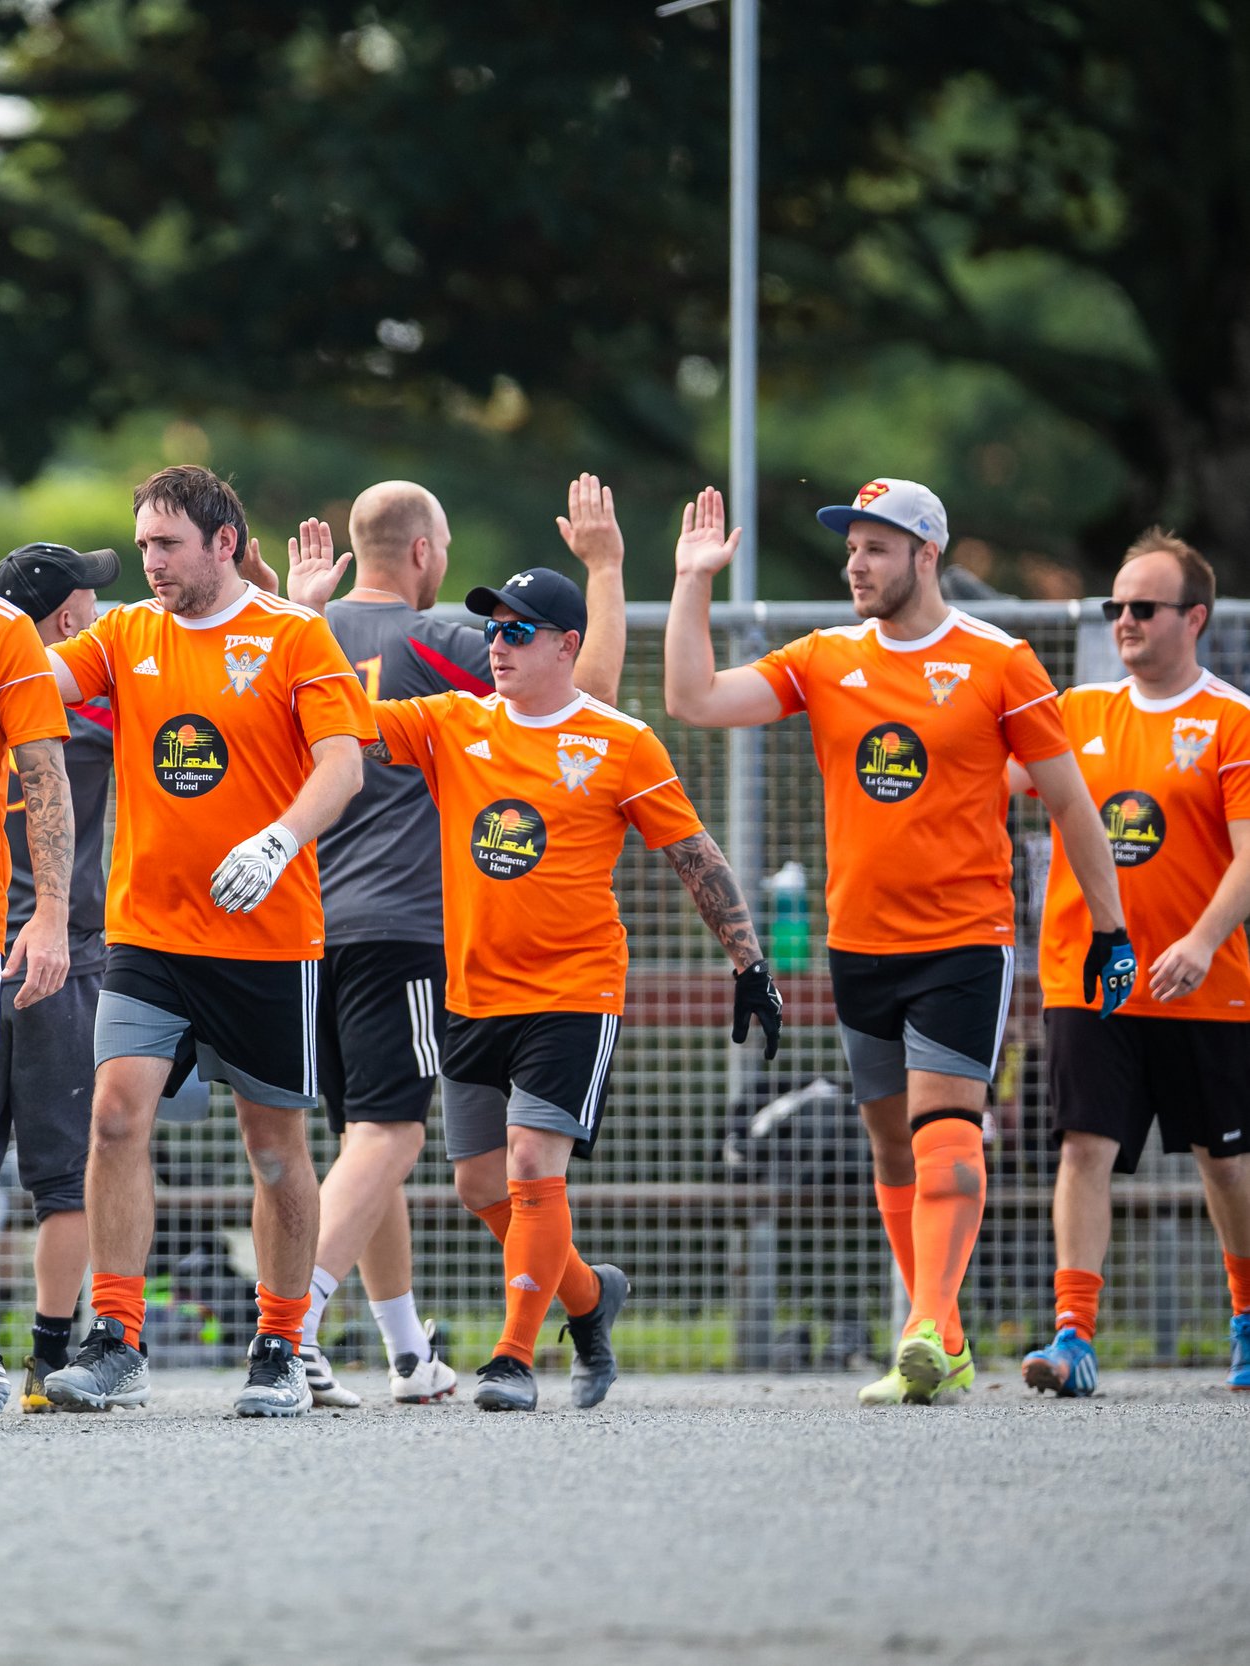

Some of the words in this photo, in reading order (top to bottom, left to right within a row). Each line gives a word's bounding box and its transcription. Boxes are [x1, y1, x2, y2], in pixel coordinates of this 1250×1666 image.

[224, 635, 274, 653] TITANS
[557, 733, 609, 756] TITANS
[164, 771, 173, 780] La
[174, 771, 213, 782] Collinette
[176, 781, 198, 791] Hotel
[478, 849, 489, 860] La
[490, 852, 527, 867] Collinette
[490, 862, 511, 874] Hotel
